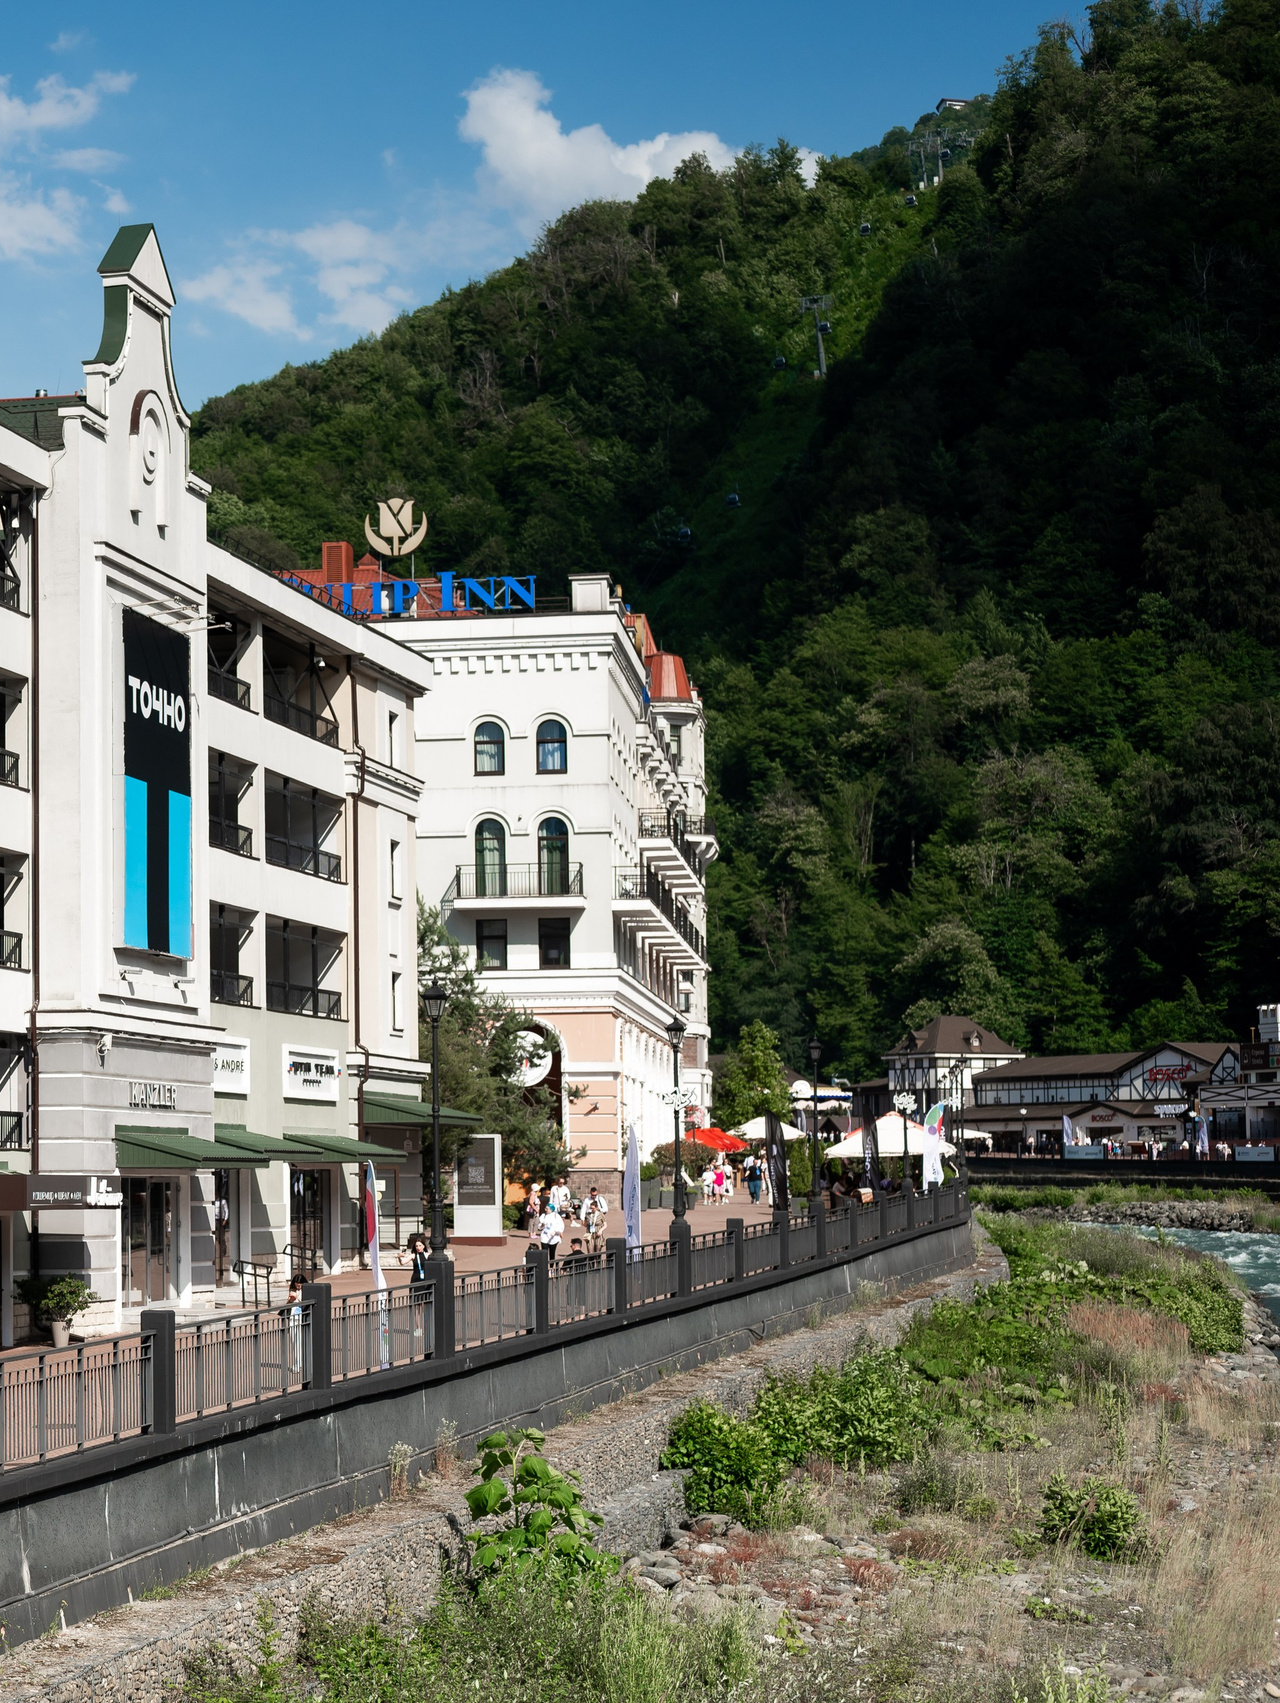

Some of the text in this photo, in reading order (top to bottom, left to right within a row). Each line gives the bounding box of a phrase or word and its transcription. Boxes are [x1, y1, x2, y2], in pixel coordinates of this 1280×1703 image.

[283, 571, 536, 615] LIP INN
[128, 675, 186, 732] ТОЧНО
[221, 1058, 244, 1072] ANDRÉ
[1148, 1067, 1187, 1082] BOSCO
[131, 1082, 178, 1106] KANZLER
[1091, 1114, 1113, 1122] BOSCO
